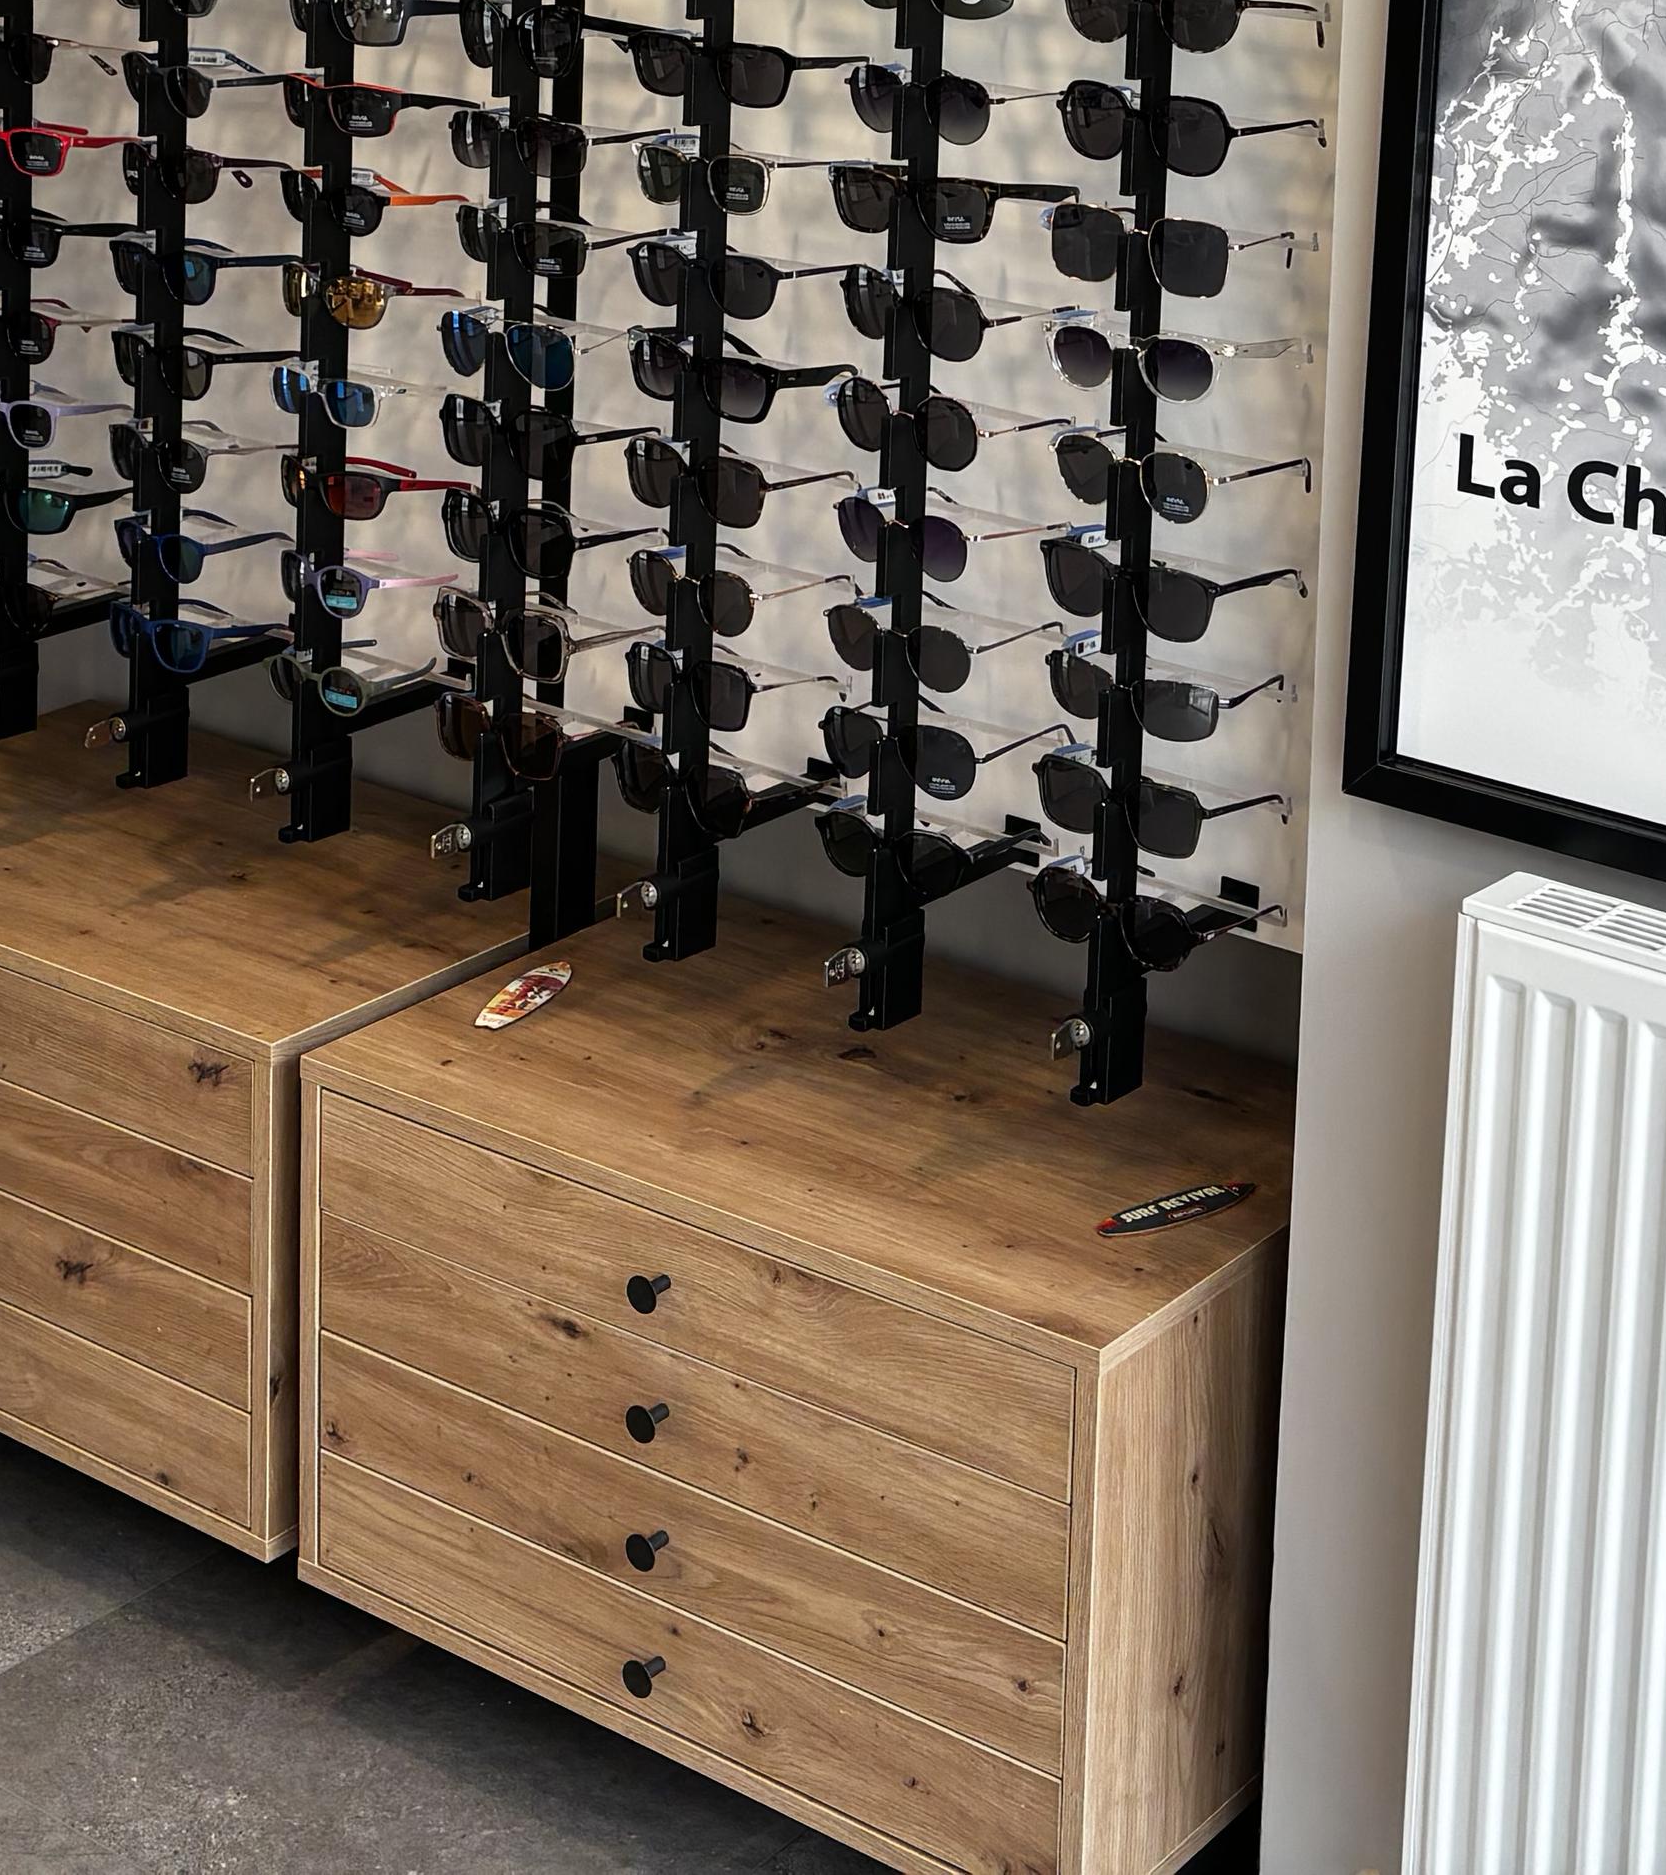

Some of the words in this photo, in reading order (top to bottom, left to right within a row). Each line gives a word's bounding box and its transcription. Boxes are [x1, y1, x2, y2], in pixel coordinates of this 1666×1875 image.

[1457, 433, 1542, 509] La
[1119, 1205, 1160, 1223] SURF
[1158, 1185, 1226, 1210] REVIVAL
